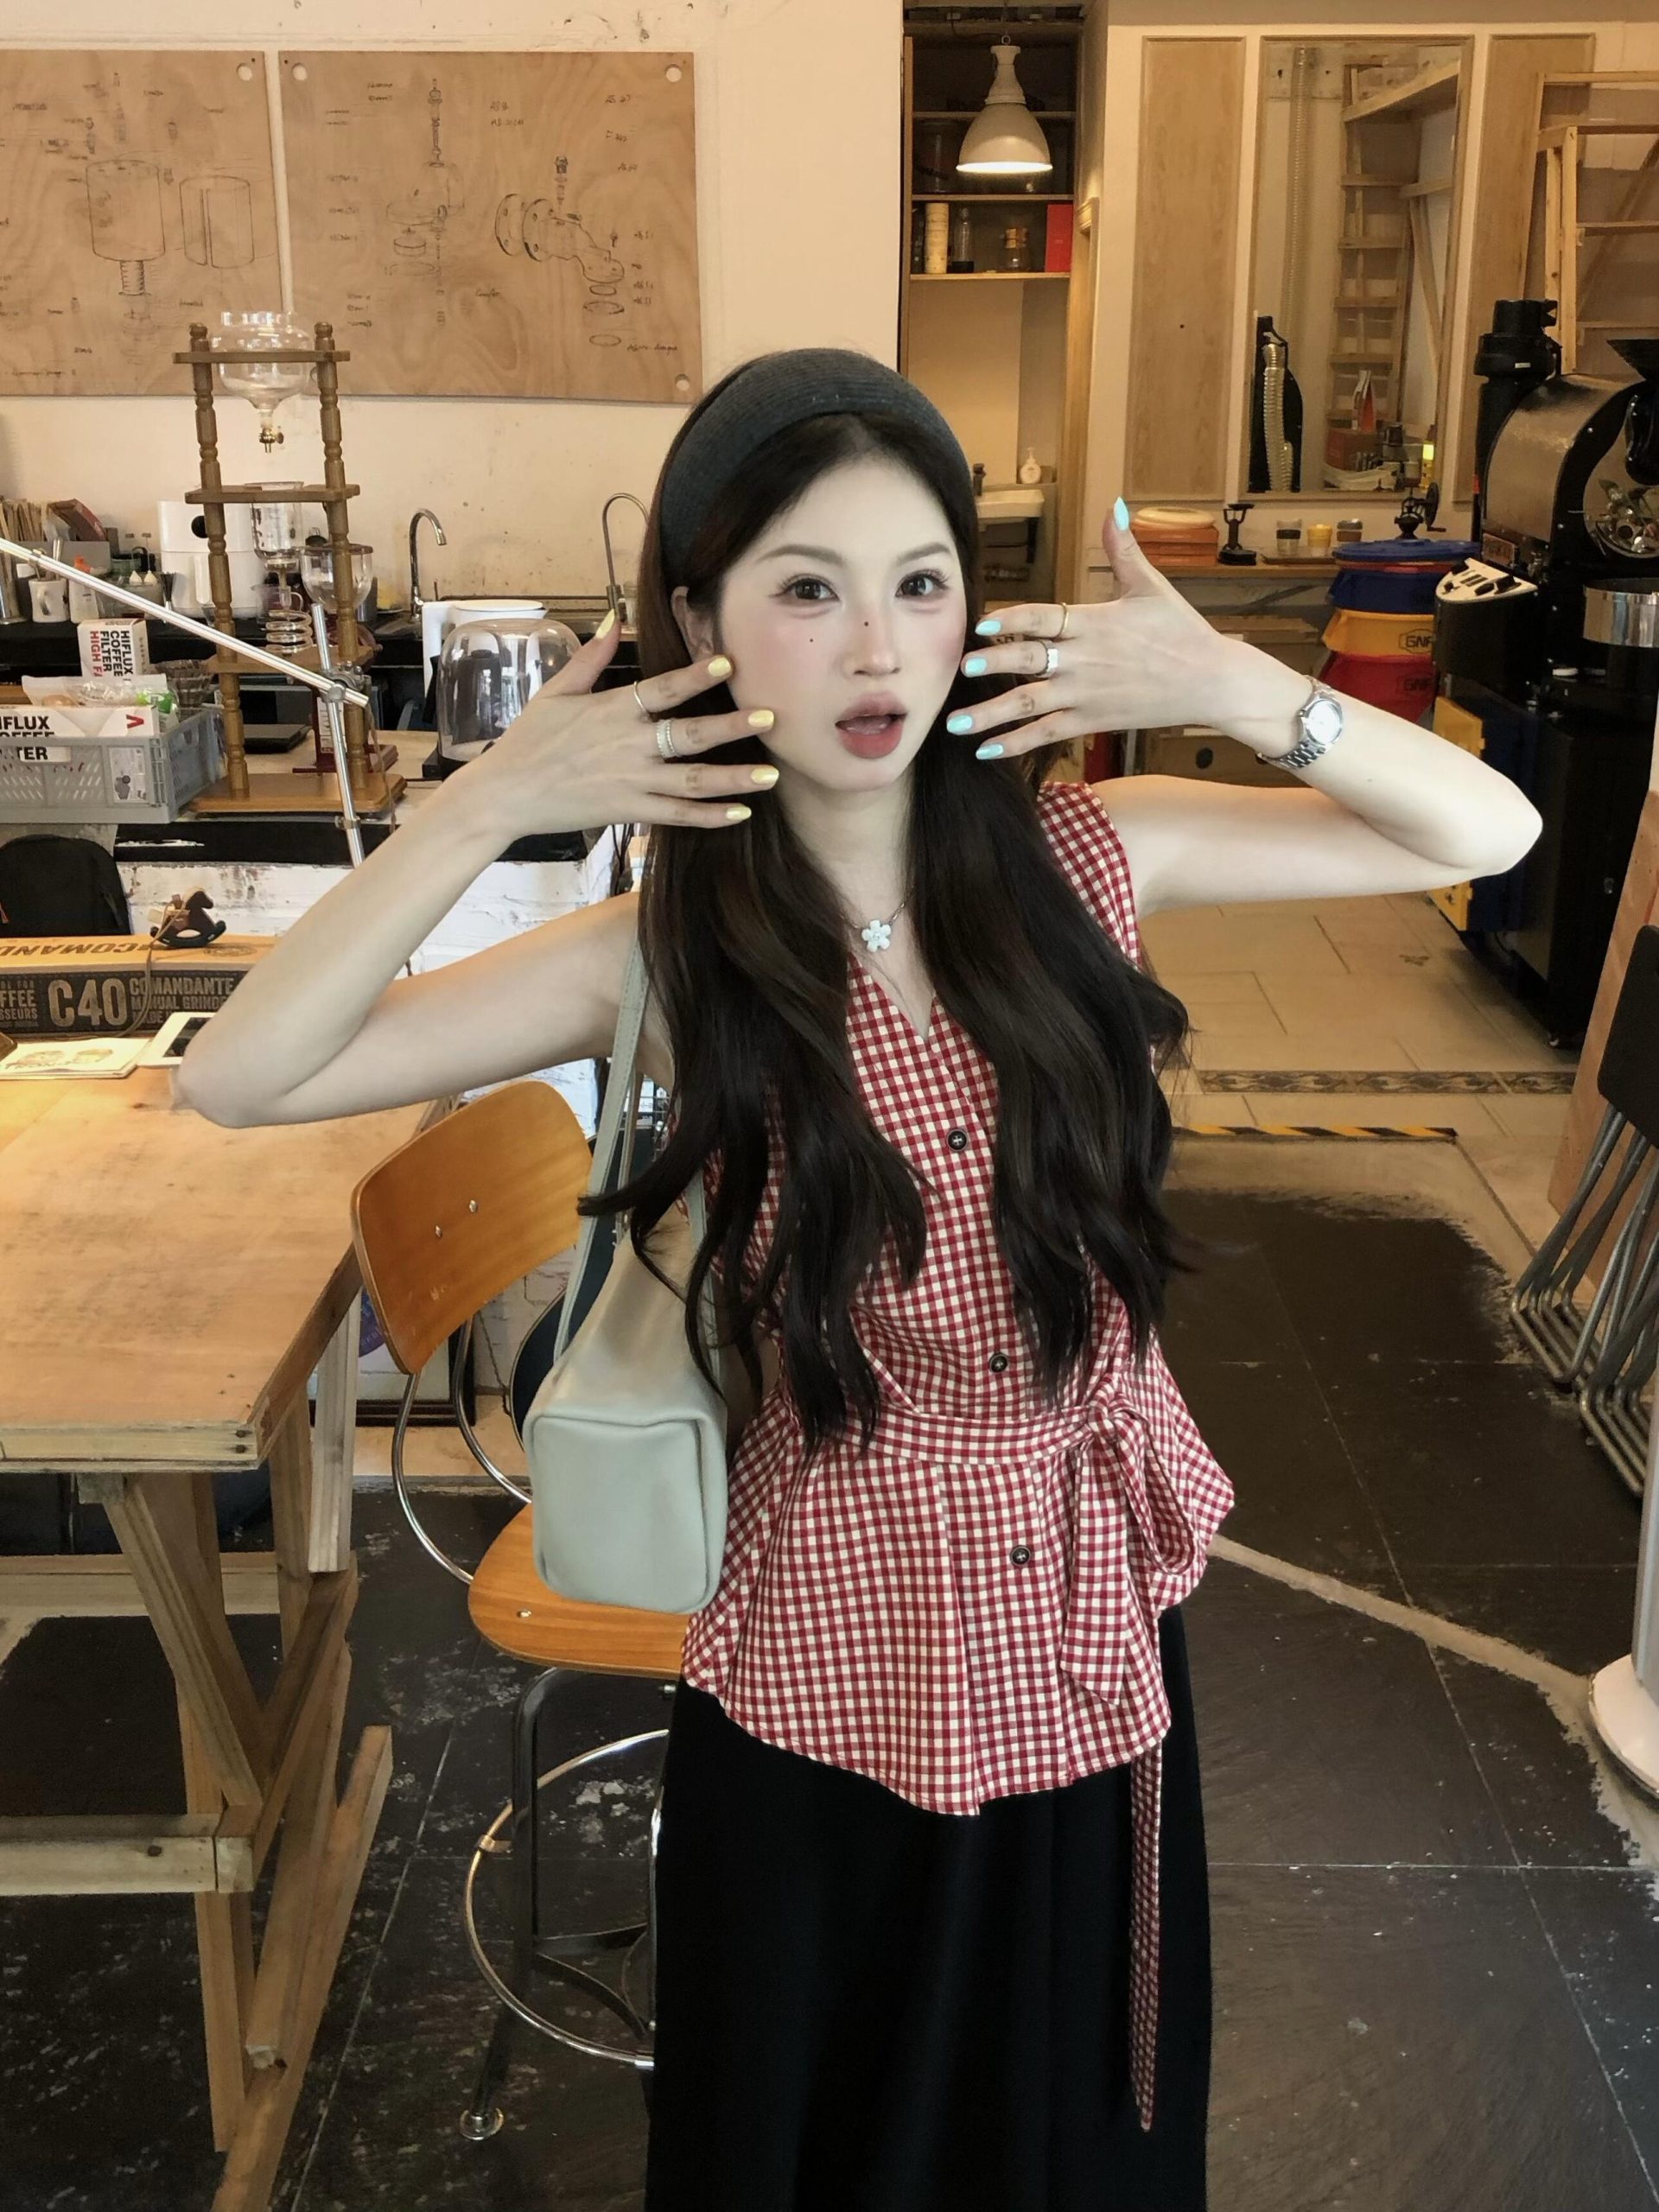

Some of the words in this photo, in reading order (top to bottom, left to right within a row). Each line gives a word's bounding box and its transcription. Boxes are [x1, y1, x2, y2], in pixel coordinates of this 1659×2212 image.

[90, 631, 101, 662] HIGH
[100, 631, 112, 672] FILTER
[110, 631, 124, 677] COFFEE
[121, 630, 134, 675] HIFLUX
[48, 977, 128, 1027] C40
